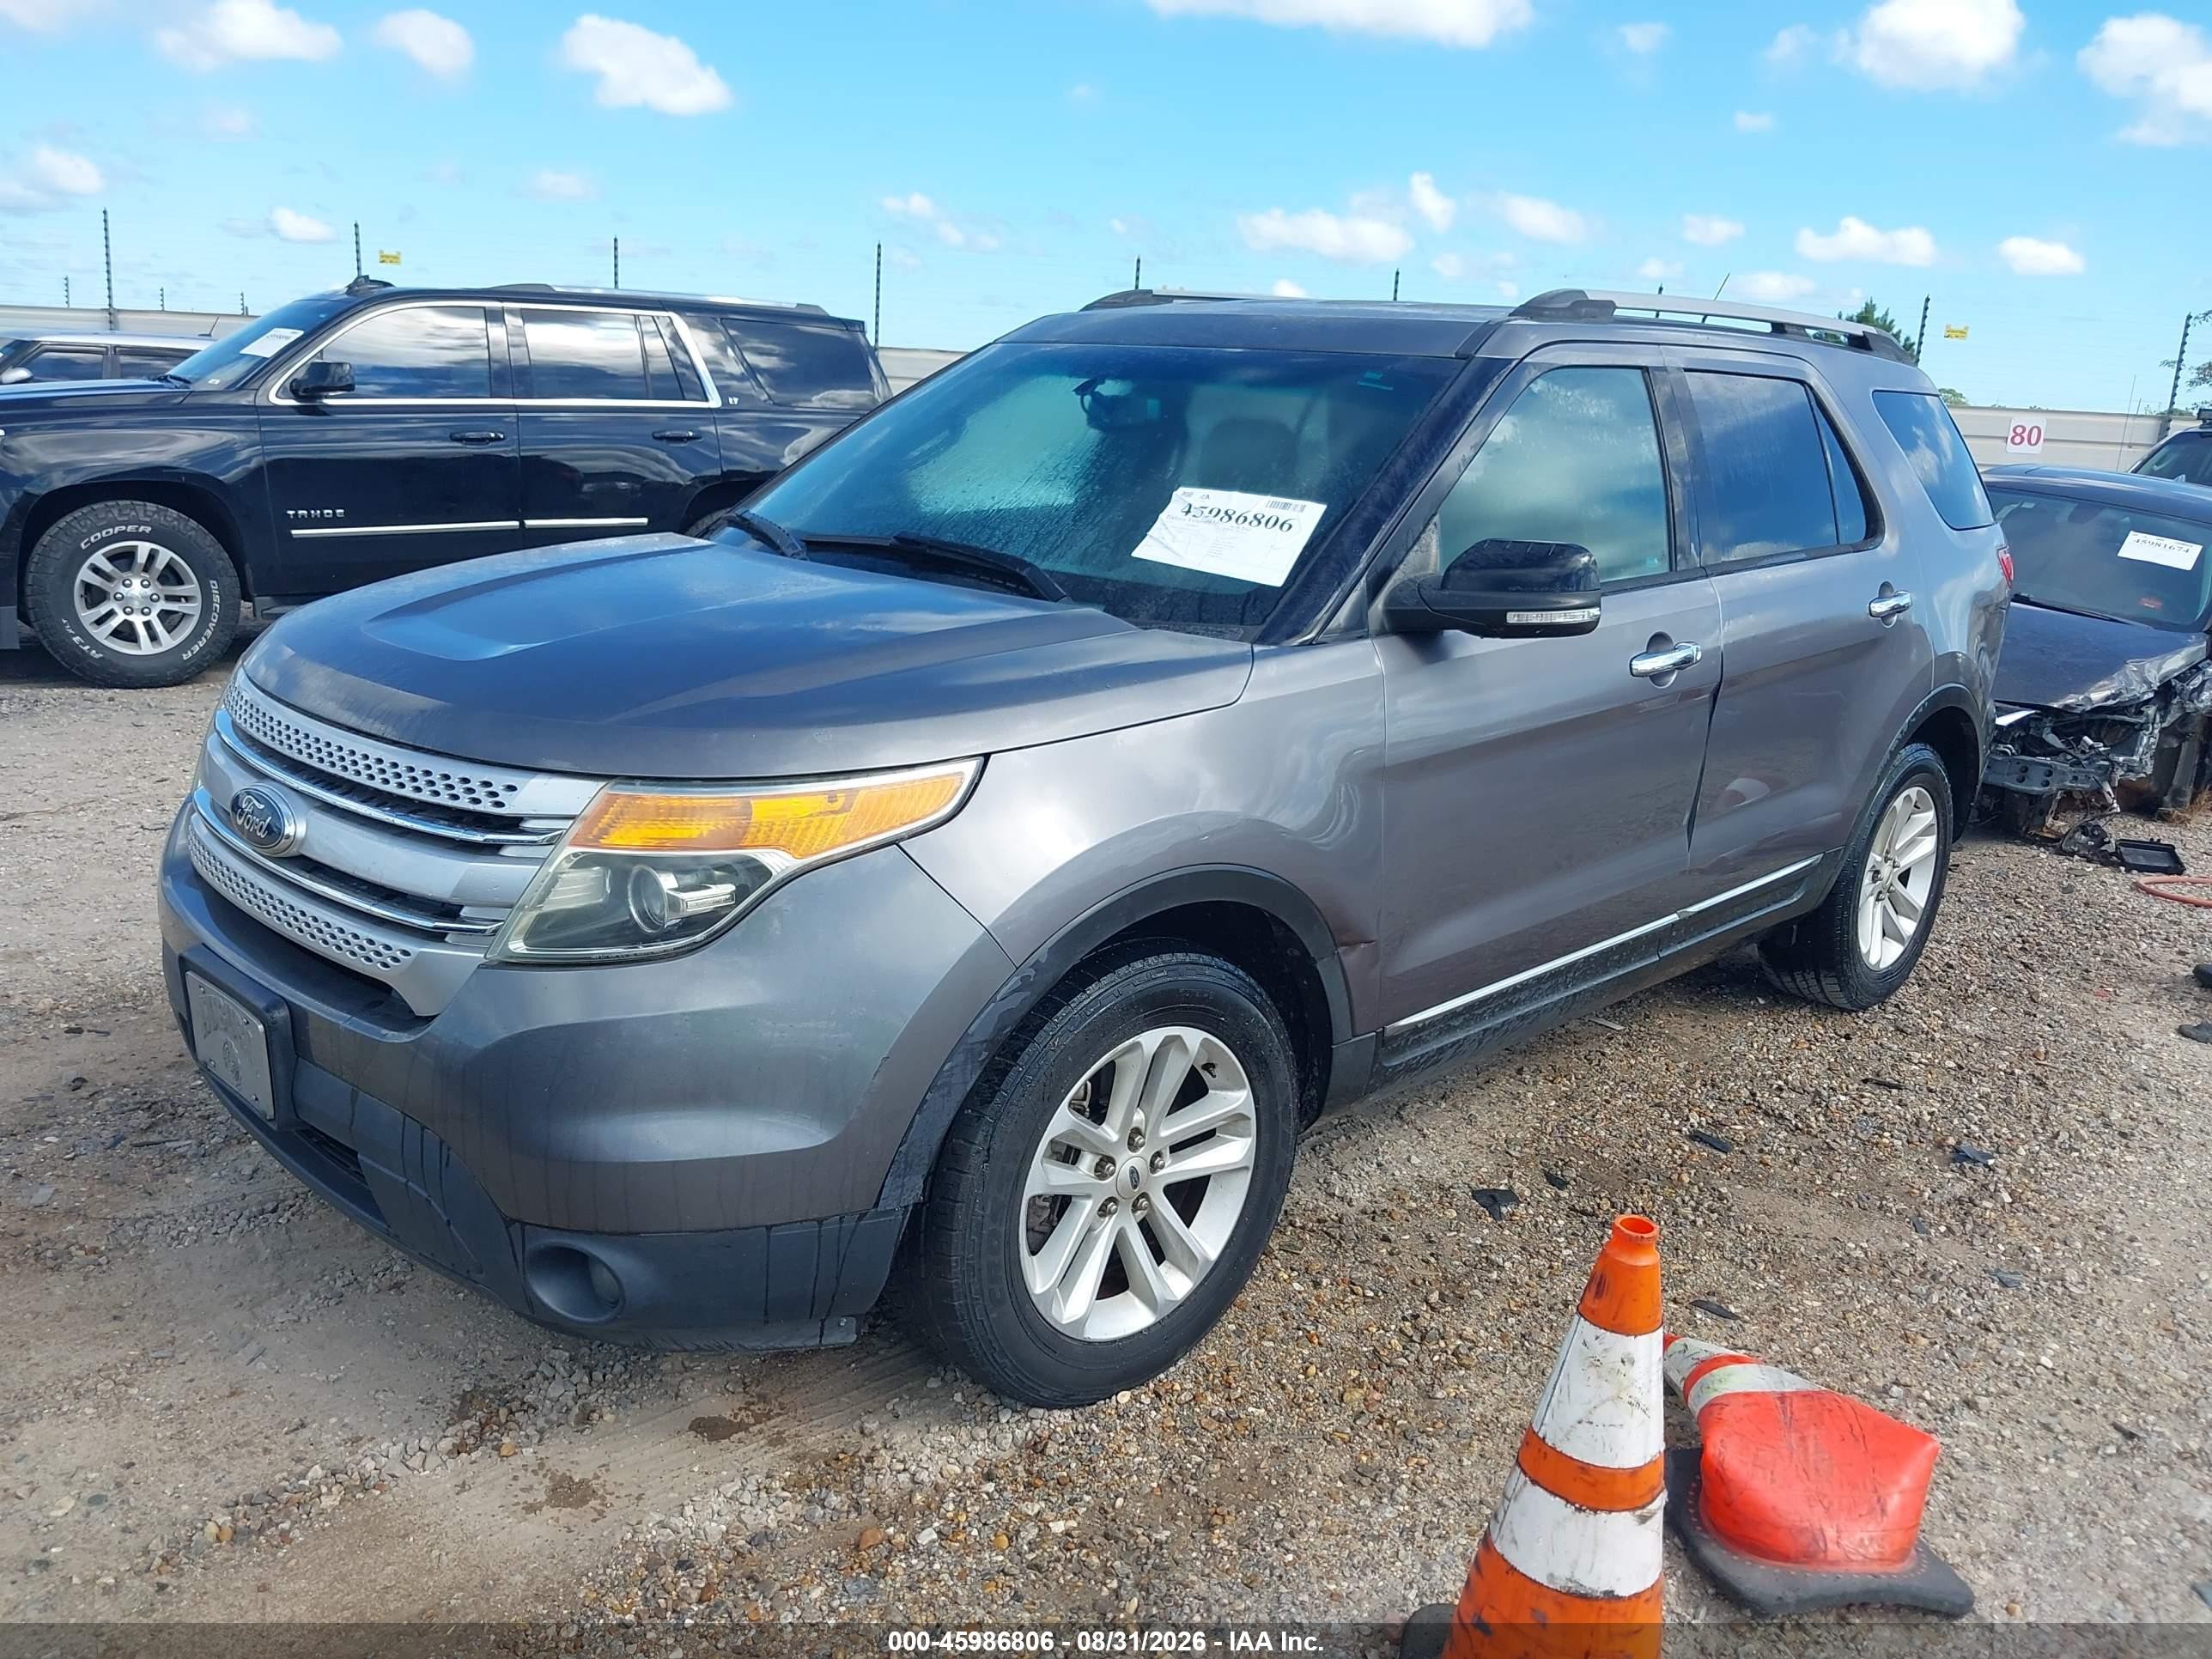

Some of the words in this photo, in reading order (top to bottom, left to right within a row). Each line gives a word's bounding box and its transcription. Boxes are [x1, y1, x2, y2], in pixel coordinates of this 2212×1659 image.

[2010, 424, 2042, 447] 80
[286, 508, 345, 519] TAHOE
[1181, 502, 1299, 533] 45986806
[80, 525, 152, 550] COOPER
[181, 579, 221, 660] DISCOVERER
[72, 635, 104, 659] AT3
[236, 794, 272, 839] Ford
